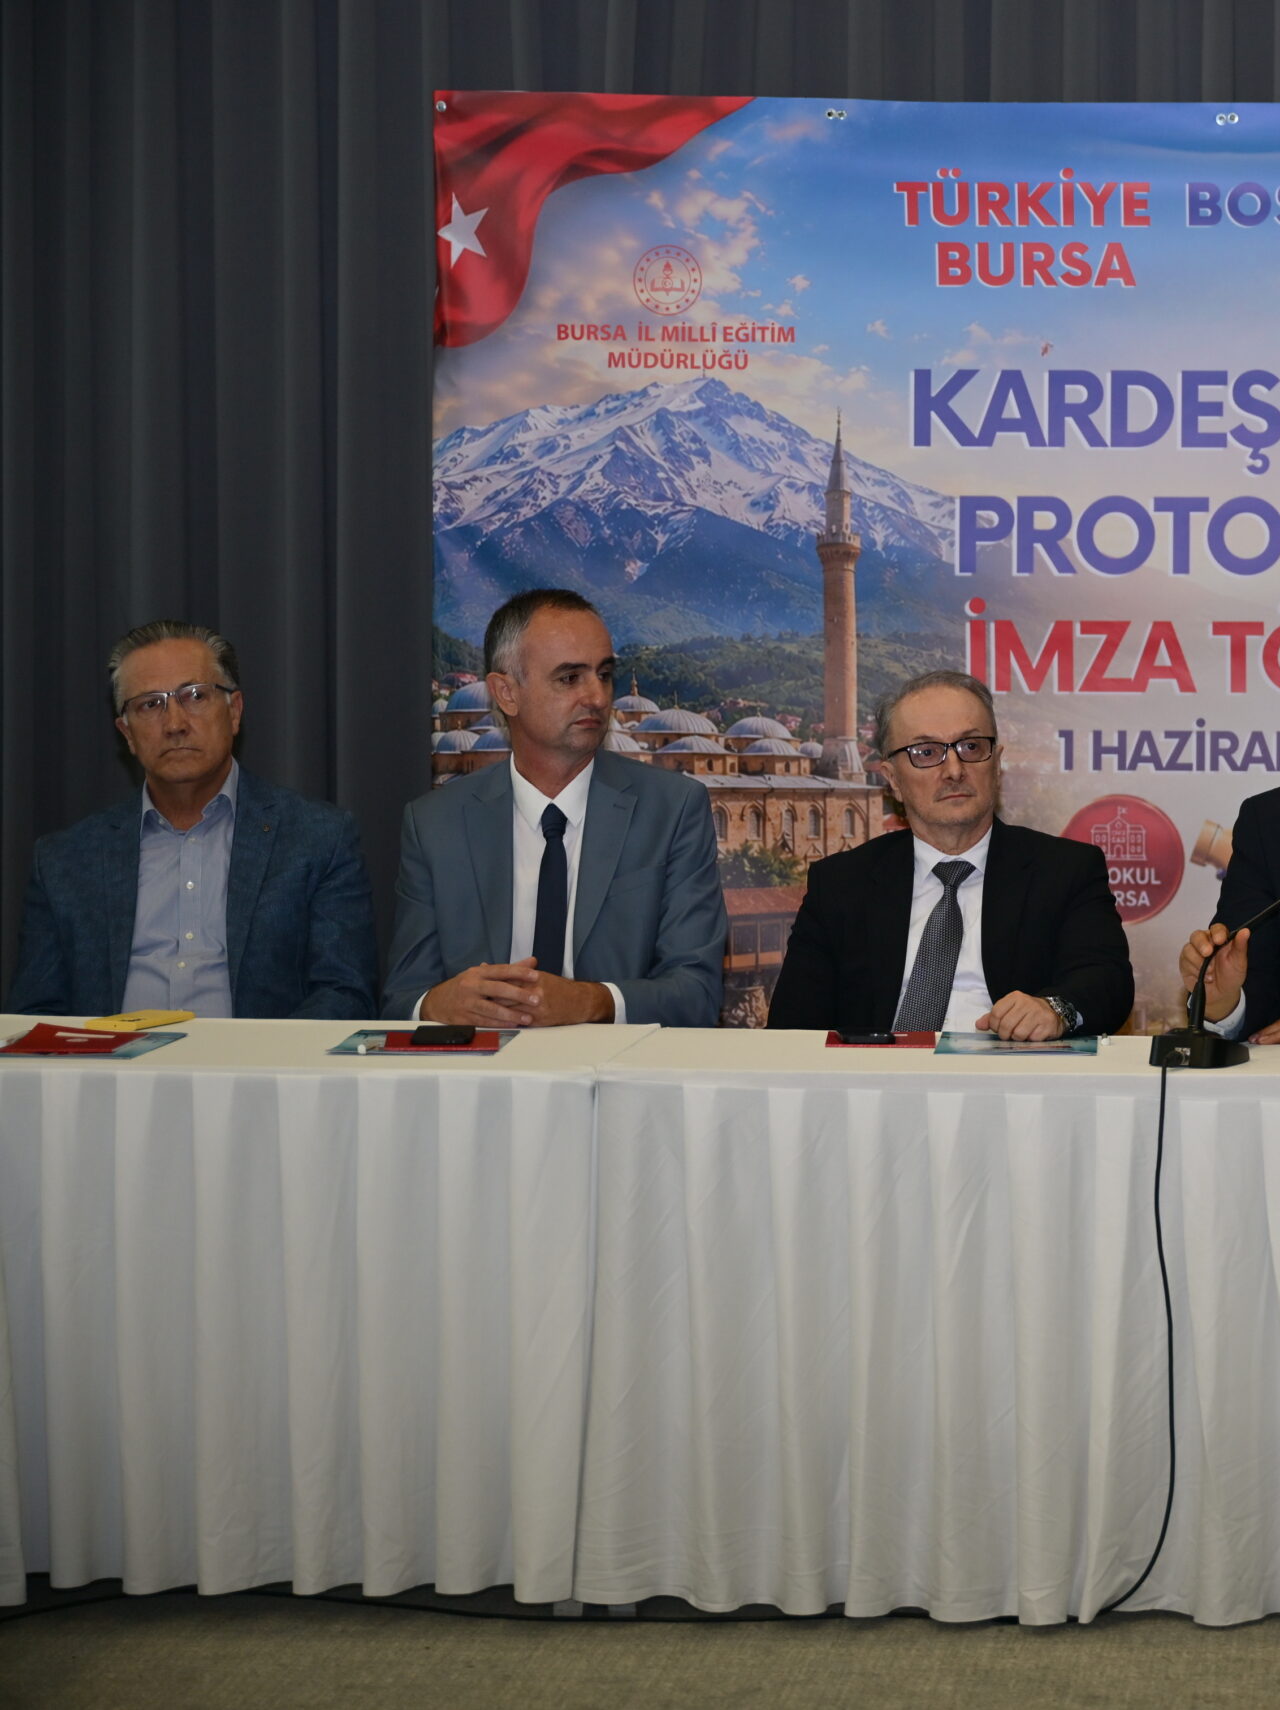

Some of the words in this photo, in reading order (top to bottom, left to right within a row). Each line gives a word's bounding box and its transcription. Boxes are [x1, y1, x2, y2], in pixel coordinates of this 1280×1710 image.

[894, 167, 1151, 228] TÜRKİYE
[936, 241, 1137, 288] BURSA
[556, 323, 627, 341] BURSA
[637, 321, 655, 342] İL
[722, 322, 796, 343] EĞİTİM
[607, 348, 749, 370] MÜDÜRLÜĞÜ
[966, 597, 1197, 695] İMZA
[1057, 730, 1074, 772] 1
[1111, 890, 1151, 907] RSA
